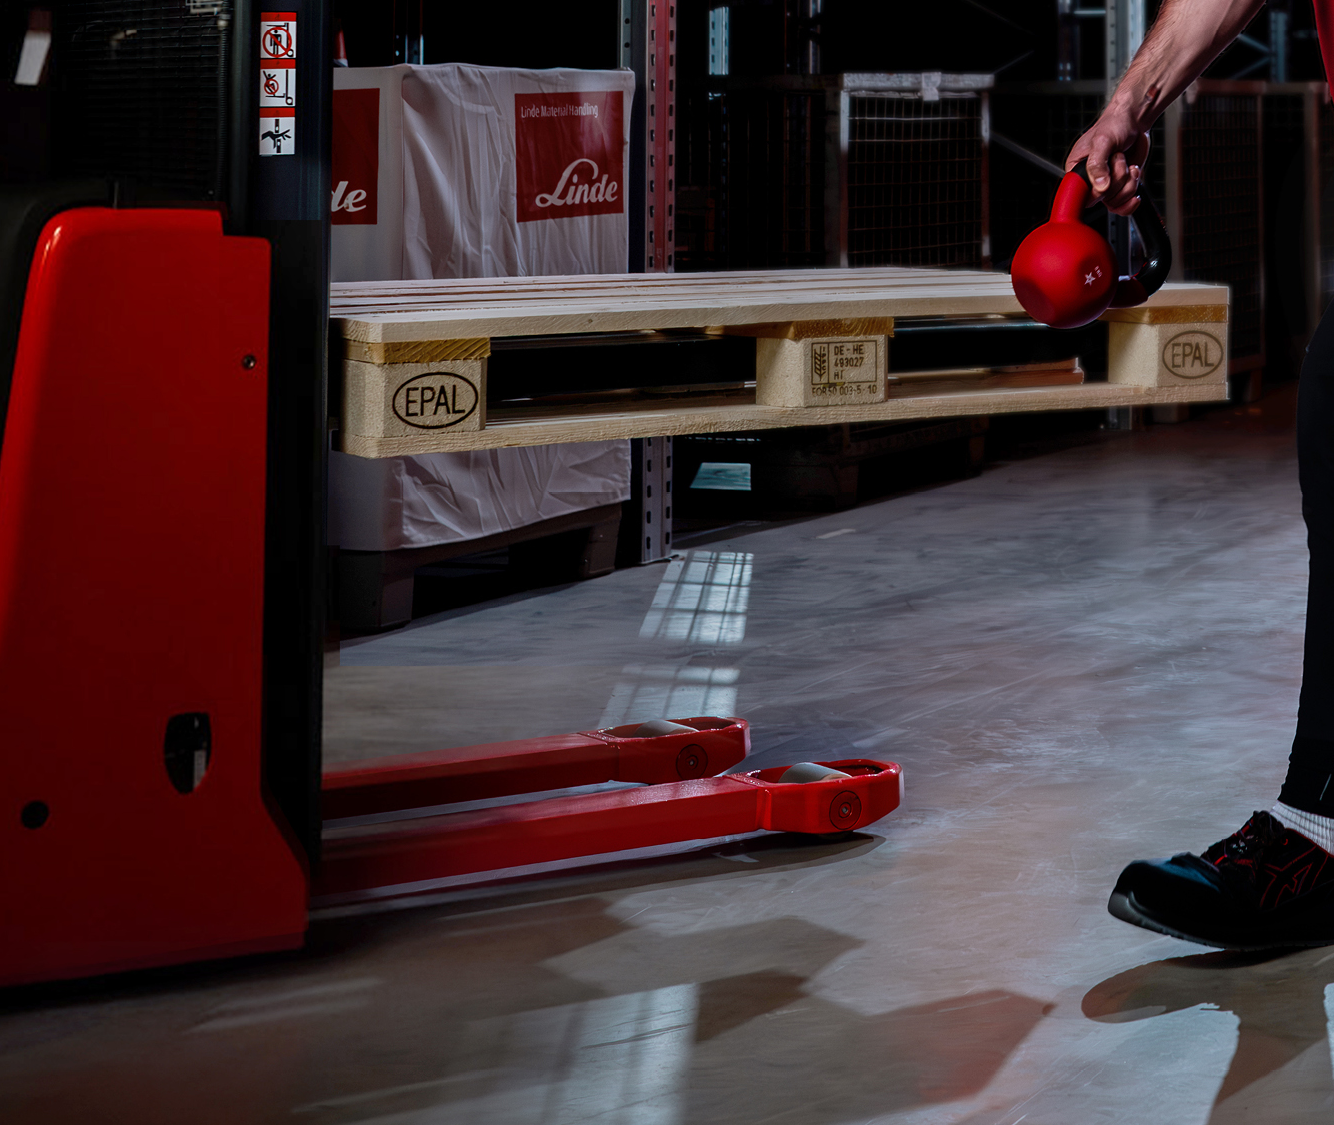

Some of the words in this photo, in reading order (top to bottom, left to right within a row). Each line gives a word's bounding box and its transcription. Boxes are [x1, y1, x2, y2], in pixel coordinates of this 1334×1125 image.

[521, 104, 540, 118] Linde
[569, 102, 598, 118] Handling
[535, 158, 618, 208] Linde
[1171, 341, 1215, 368] EPAL
[406, 384, 466, 416] EPAL
